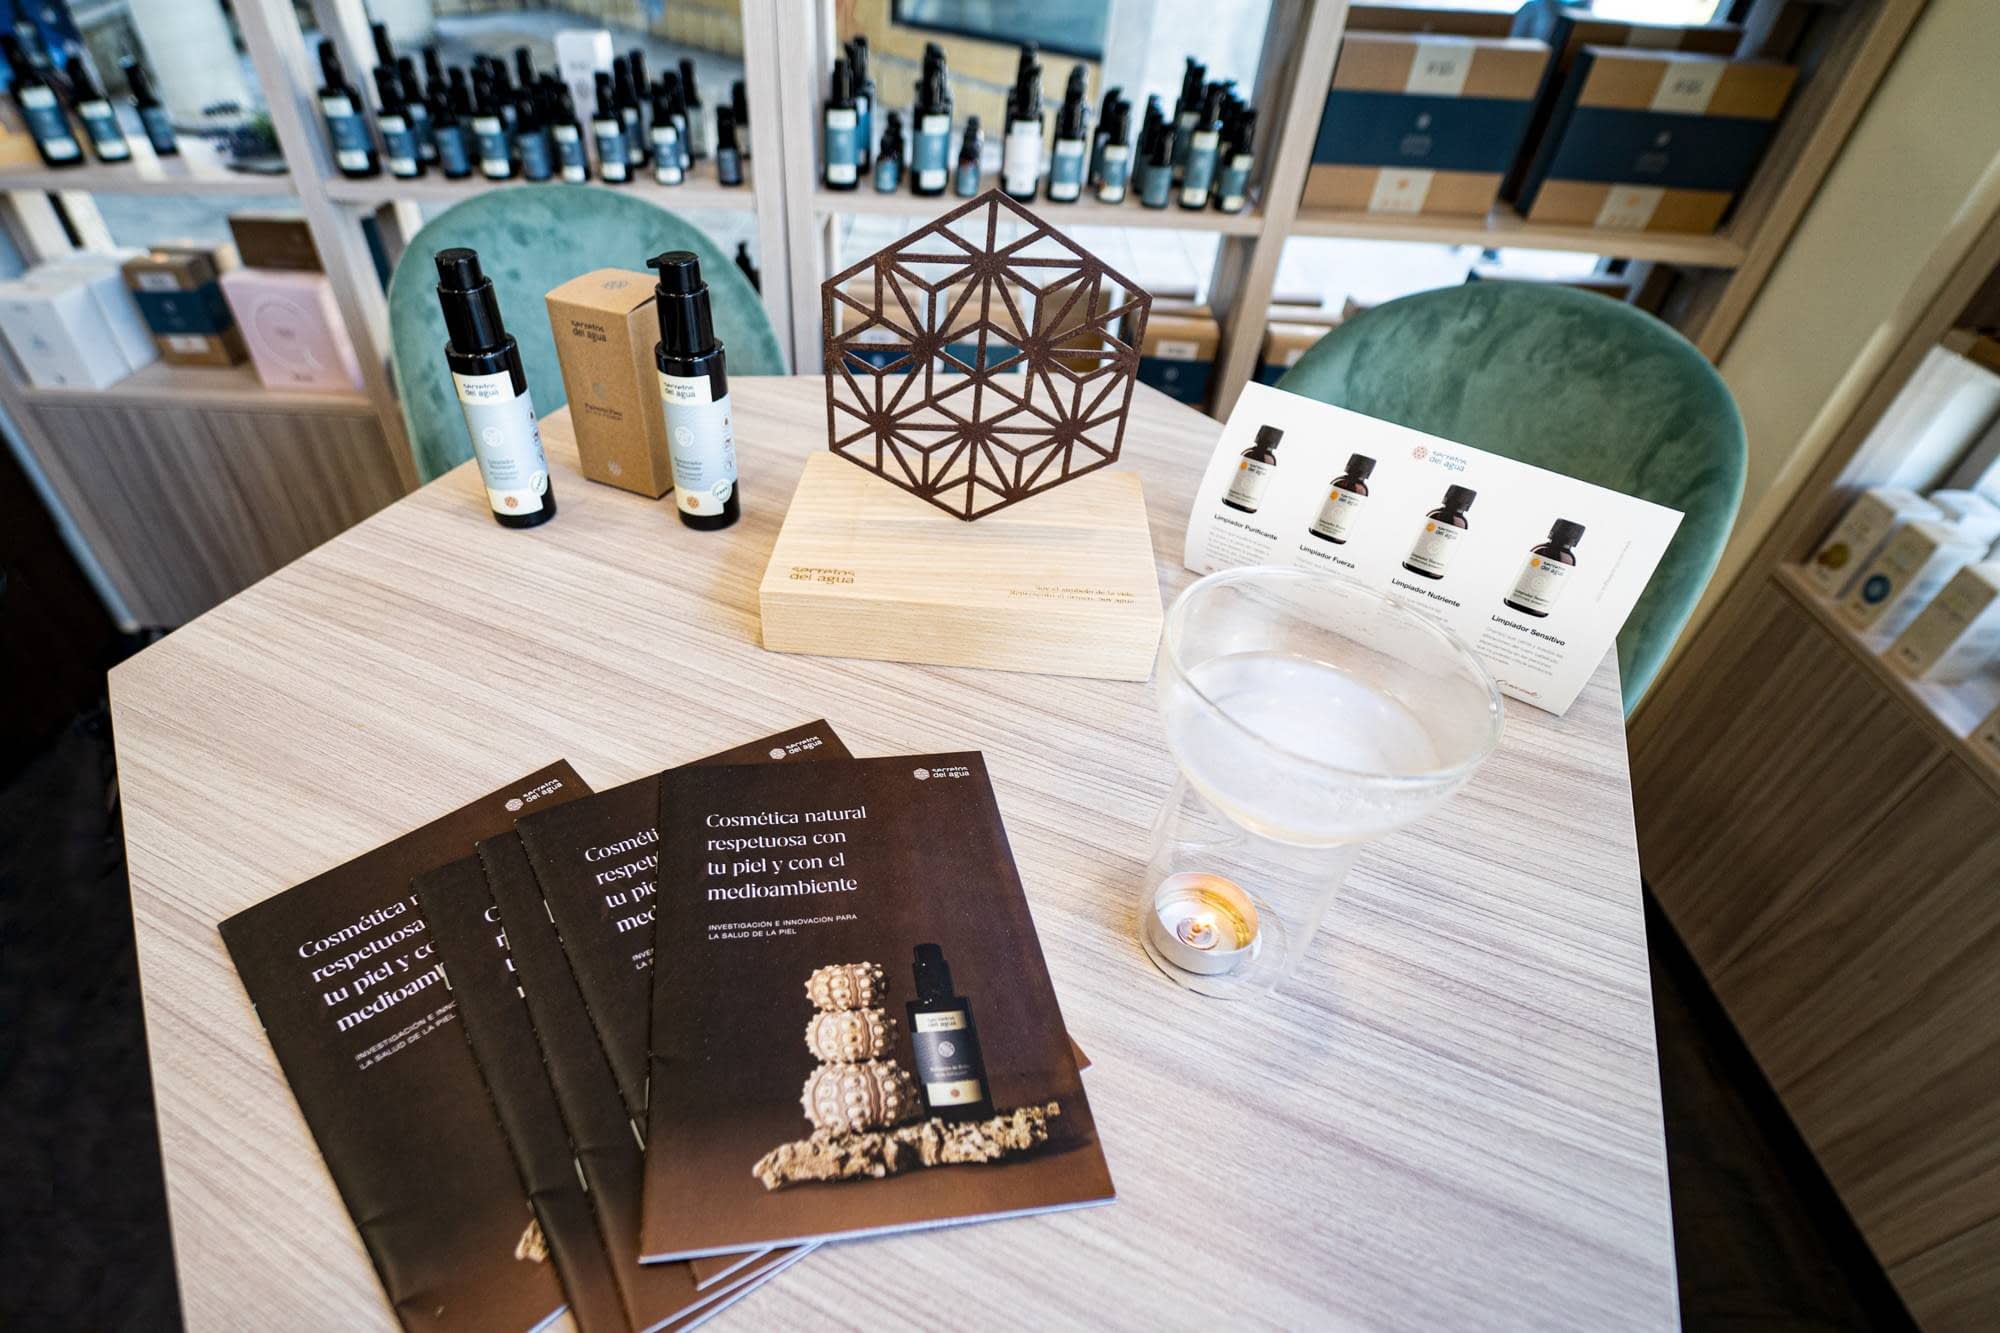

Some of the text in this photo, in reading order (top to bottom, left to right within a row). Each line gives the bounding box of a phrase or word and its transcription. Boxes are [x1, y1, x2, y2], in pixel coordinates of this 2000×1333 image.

[587, 331, 607, 343] agua
[676, 390, 696, 400] agua
[1213, 513, 1278, 541] Limpiador Purificante
[1299, 544, 1356, 570] Limpiador Fuerza
[789, 573, 854, 585] del agua
[1391, 577, 1461, 608] Limpiador Nutriente
[1491, 614, 1566, 646] Limpiador Sensitivo
[788, 739, 823, 755] del agua
[932, 770, 971, 779] del agua
[526, 782, 563, 803] del agua
[706, 805, 867, 828] Cosmética natural
[584, 828, 660, 862] Cosméti
[707, 831, 847, 853] respetuosa con
[707, 852, 846, 877] tu piel y con el
[605, 891, 628, 909] tu
[707, 878, 858, 901] medioambiente
[298, 902, 407, 959] Cosmética
[775, 920, 780, 928] E
[835, 913, 858, 922] PARA
[708, 927, 797, 941] LA SALUD DE LA PIEL
[311, 919, 426, 984] respetuosa
[322, 986, 350, 1007] tu
[352, 961, 395, 996] piel
[395, 954, 409, 973] y
[359, 1012, 457, 1071] LA SALUD DE LA PIEL
